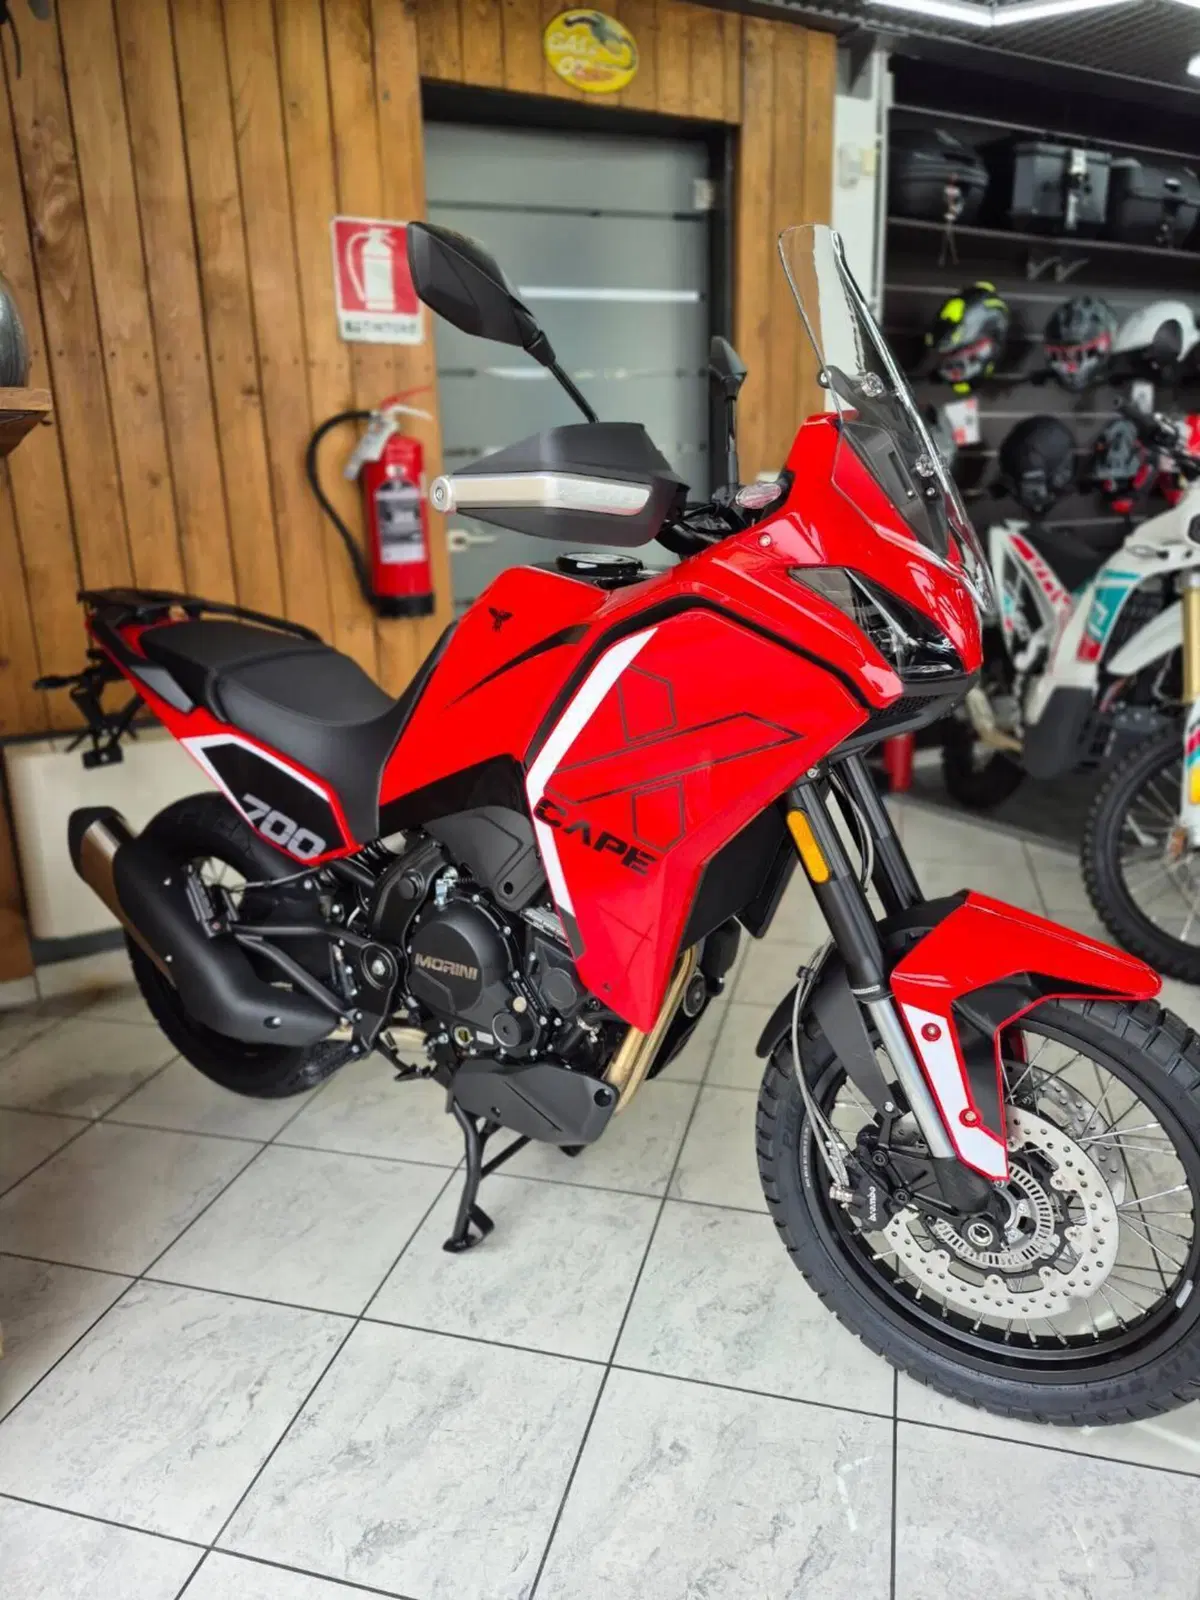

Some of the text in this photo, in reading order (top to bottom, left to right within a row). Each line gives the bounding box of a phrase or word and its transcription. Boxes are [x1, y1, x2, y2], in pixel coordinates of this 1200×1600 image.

[243, 793, 326, 859] 700
[534, 797, 657, 875] CAPE
[415, 953, 478, 980] MORINI
